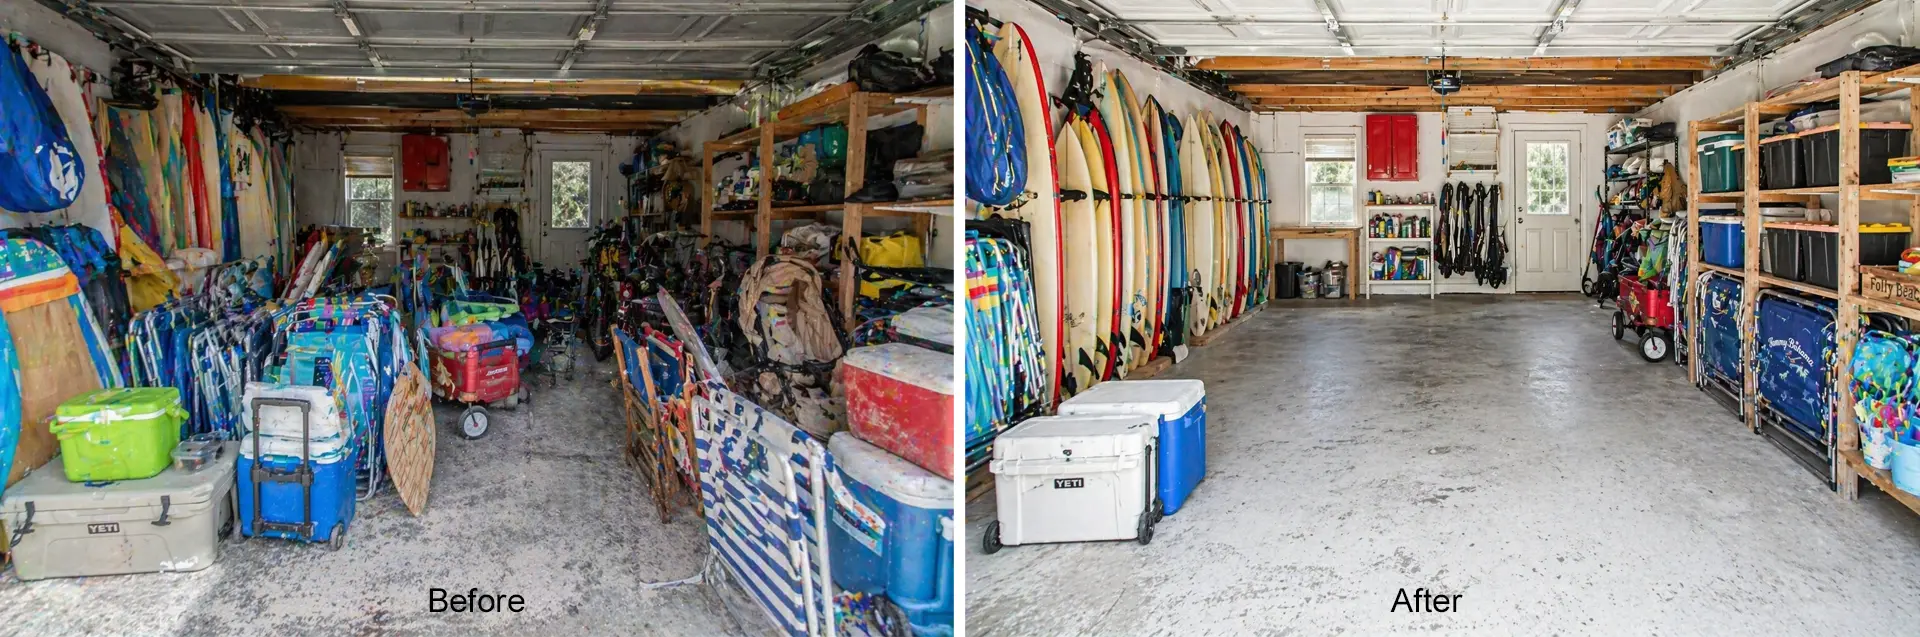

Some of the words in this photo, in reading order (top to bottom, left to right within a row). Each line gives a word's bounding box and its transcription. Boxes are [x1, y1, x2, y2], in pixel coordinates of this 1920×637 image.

[1870, 277, 1893, 300] Folly
[1056, 480, 1083, 488] YETI
[89, 524, 118, 533] YETI
